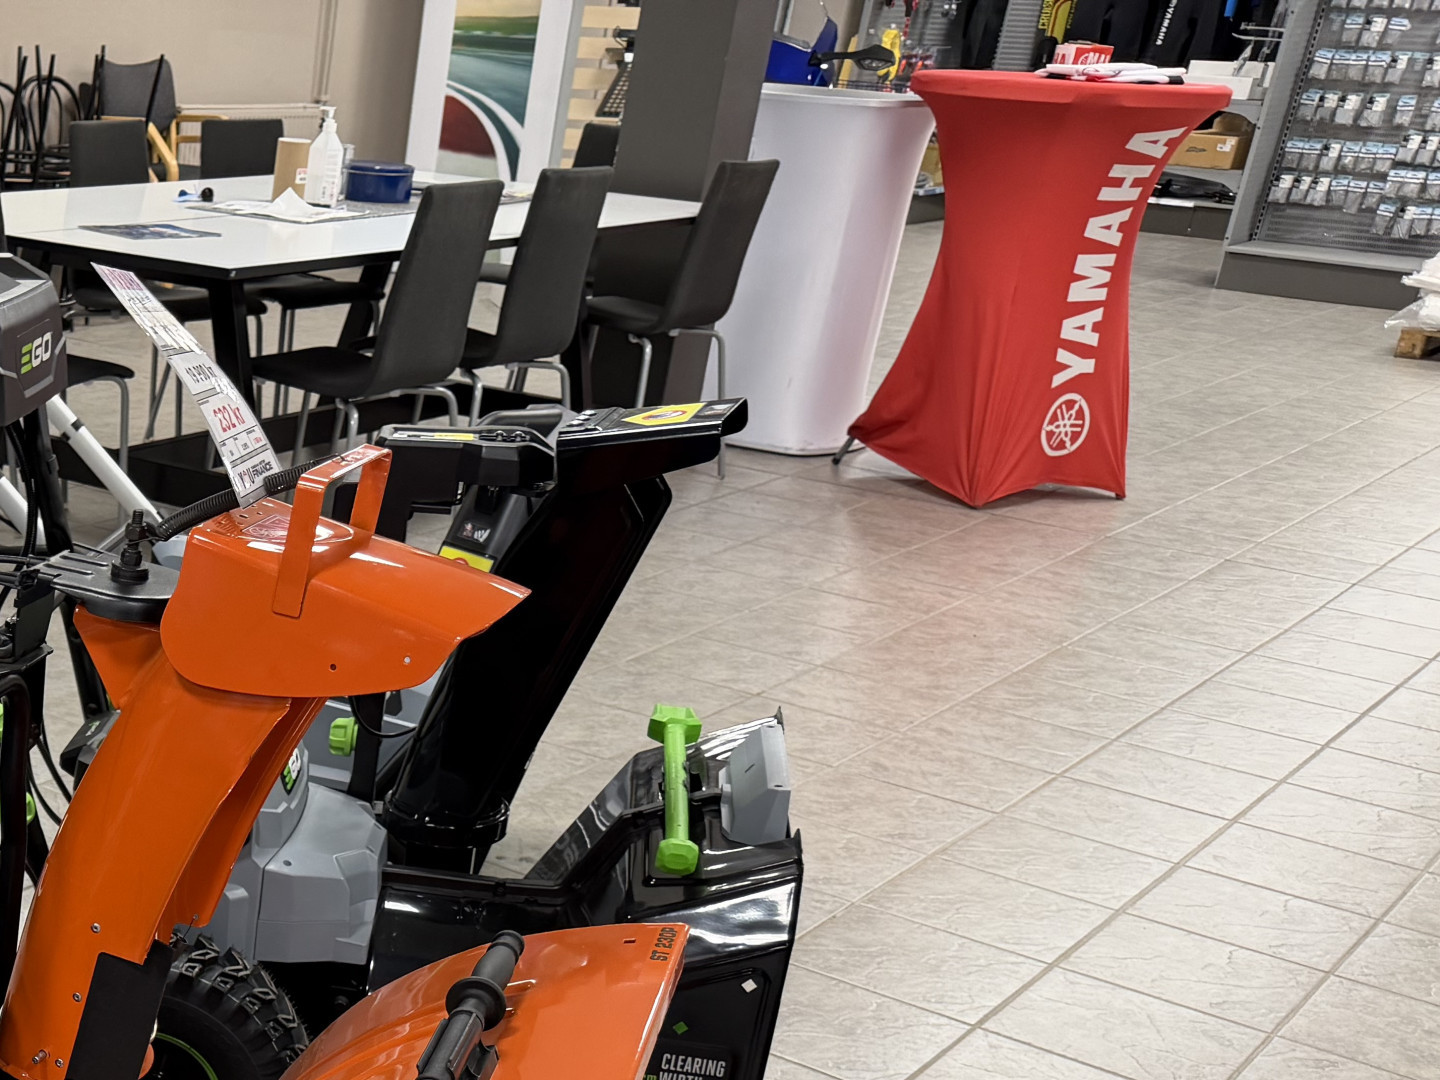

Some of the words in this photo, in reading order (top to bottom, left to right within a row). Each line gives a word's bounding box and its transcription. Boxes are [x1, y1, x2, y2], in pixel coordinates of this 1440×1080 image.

[1051, 126, 1188, 389] YAMAHA
[21, 331, 53, 374] EGO
[213, 403, 236, 433] 232
[655, 927, 678, 949] 230P
[661, 1053, 726, 1077] CLEARING
